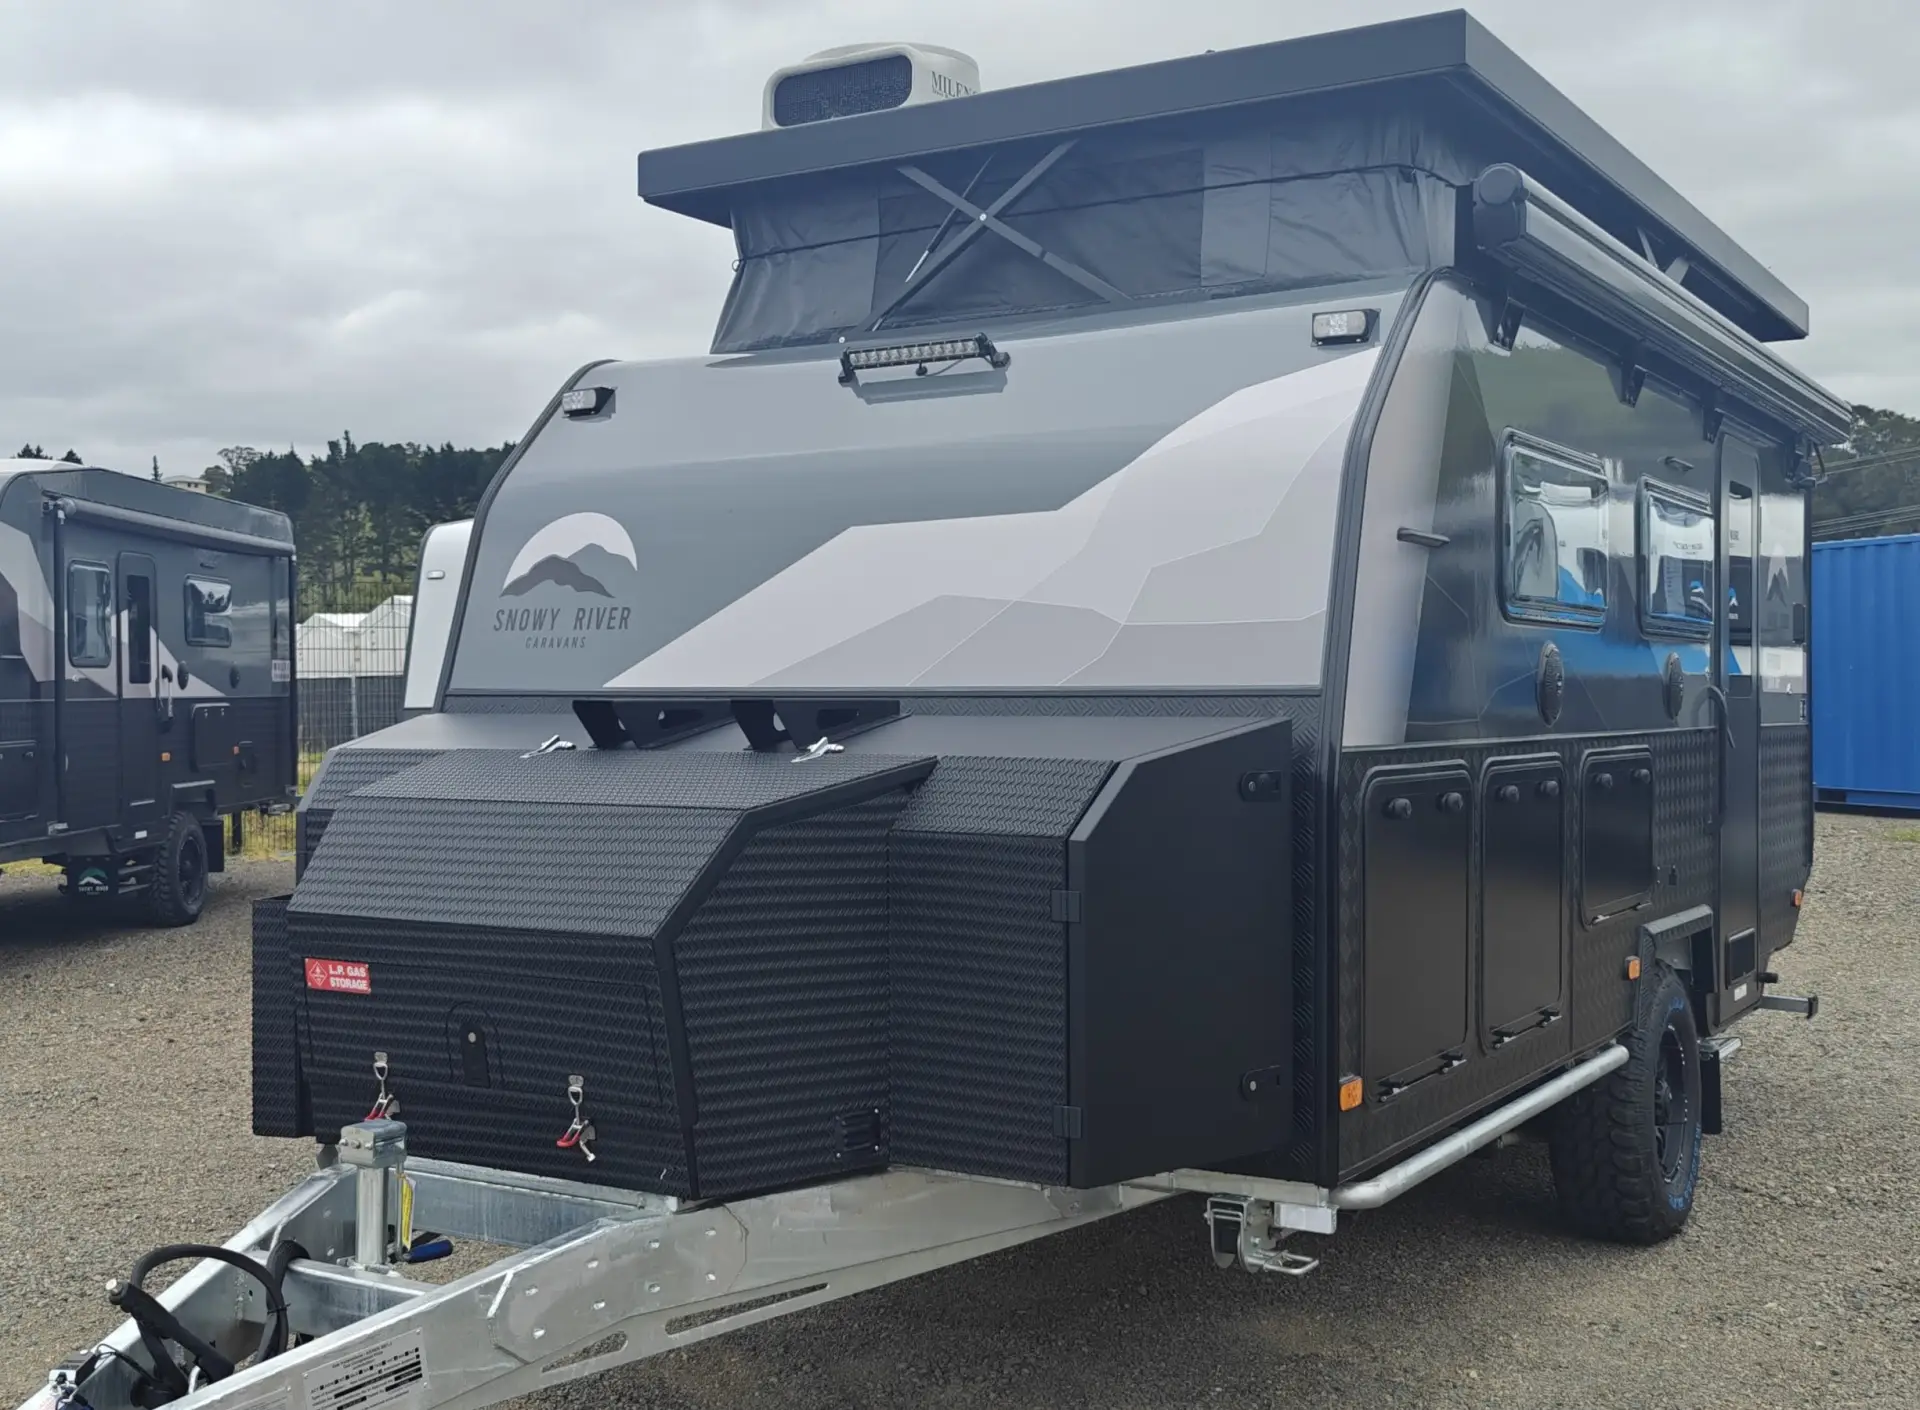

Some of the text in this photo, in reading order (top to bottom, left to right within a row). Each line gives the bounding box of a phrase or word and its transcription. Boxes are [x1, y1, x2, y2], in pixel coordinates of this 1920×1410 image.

[931, 70, 977, 98] MILEN
[494, 607, 631, 631] SNOWY RIVER
[525, 636, 586, 649] CARAVANS
[346, 966, 367, 977] GAS
[329, 977, 369, 990] STORAGE
